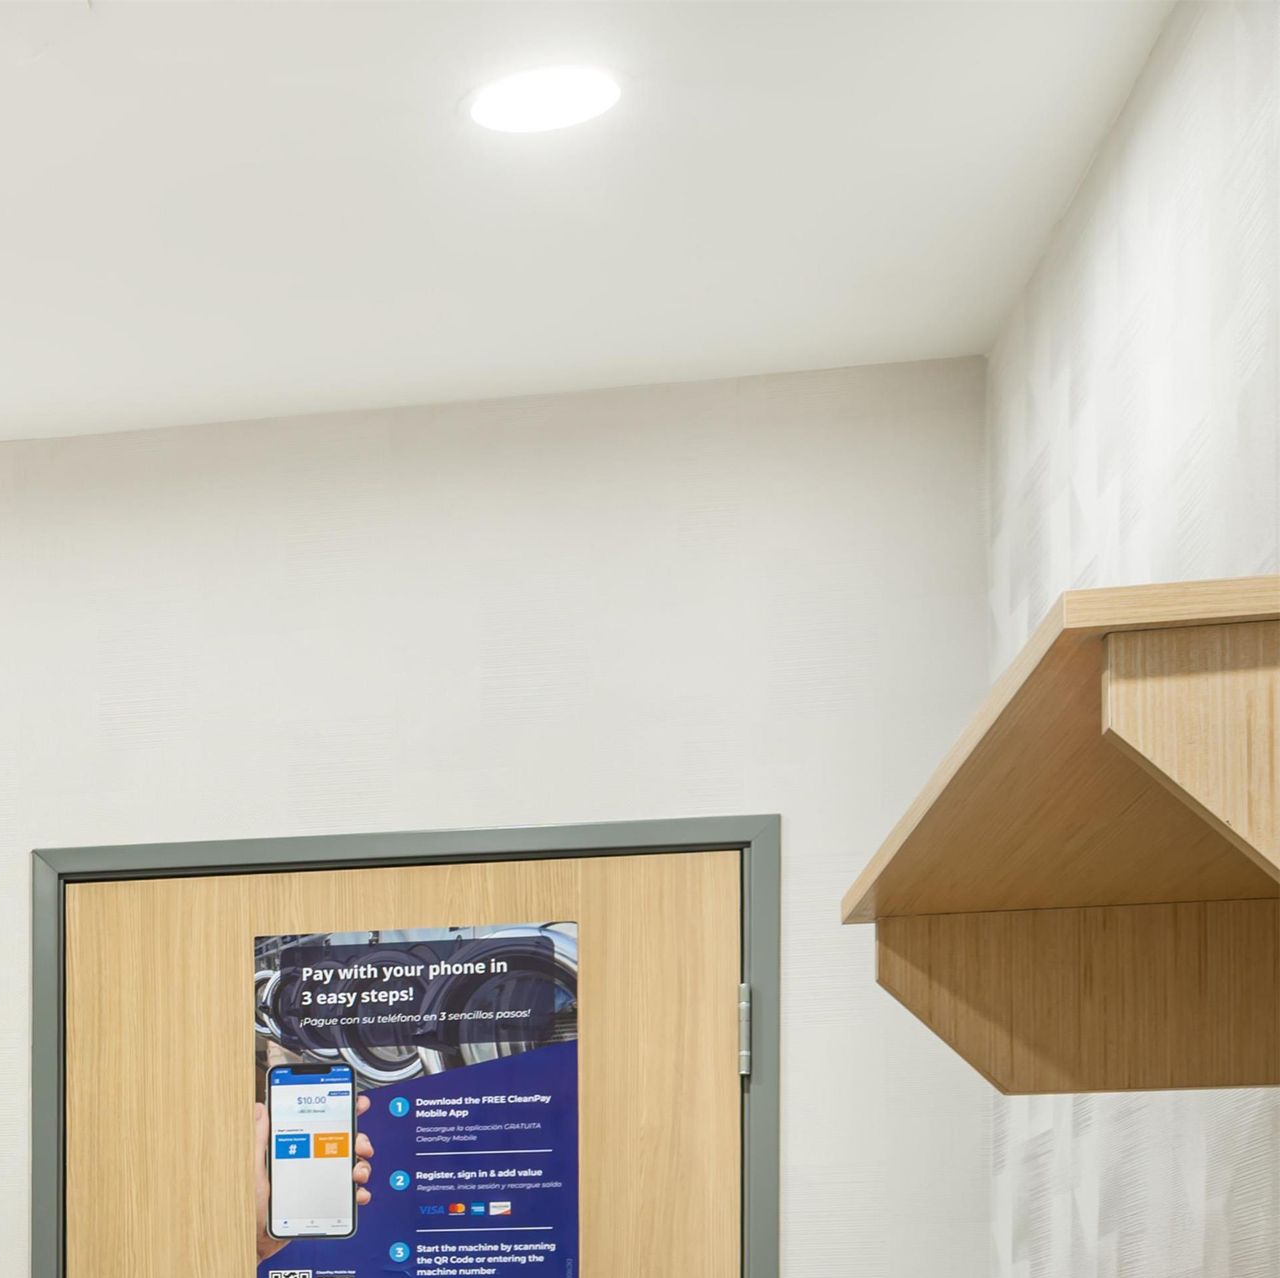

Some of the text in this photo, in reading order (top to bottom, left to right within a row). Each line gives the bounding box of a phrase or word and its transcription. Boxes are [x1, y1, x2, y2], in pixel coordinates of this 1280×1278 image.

[302, 958, 508, 984] Pay with your phone in
[301, 987, 414, 1007] 3 easy steps!
[340, 1016, 360, 1025] con
[361, 1016, 375, 1024] su
[377, 1013, 421, 1024] teléfono
[423, 1014, 437, 1022] en
[438, 1012, 447, 1021] 3
[448, 1010, 494, 1020] sencillos
[495, 1009, 531, 1020] pasos!
[297, 1096, 327, 1105] $10.00
[416, 1094, 551, 1106] Download the FREE CleanPay
[396, 1102, 403, 1113] 1
[416, 1109, 469, 1118] Mobile App
[416, 1126, 455, 1134] Descargue
[504, 1122, 541, 1131] GRATUITA
[452, 1134, 477, 1142] Mobile
[416, 1168, 543, 1181] Register, sign in & add value
[395, 1176, 404, 1186] 2
[501, 1183, 507, 1191] y
[542, 1180, 562, 1188] saldo
[419, 1205, 444, 1215] VISA
[395, 1247, 404, 1257] 3
[416, 1242, 556, 1253] Start the machine by scanning
[416, 1256, 432, 1264] the
[433, 1256, 449, 1265] QR
[450, 1255, 475, 1264] Code
[487, 1254, 527, 1264] entering
[528, 1254, 544, 1263] the
[416, 1267, 496, 1276] machine number
